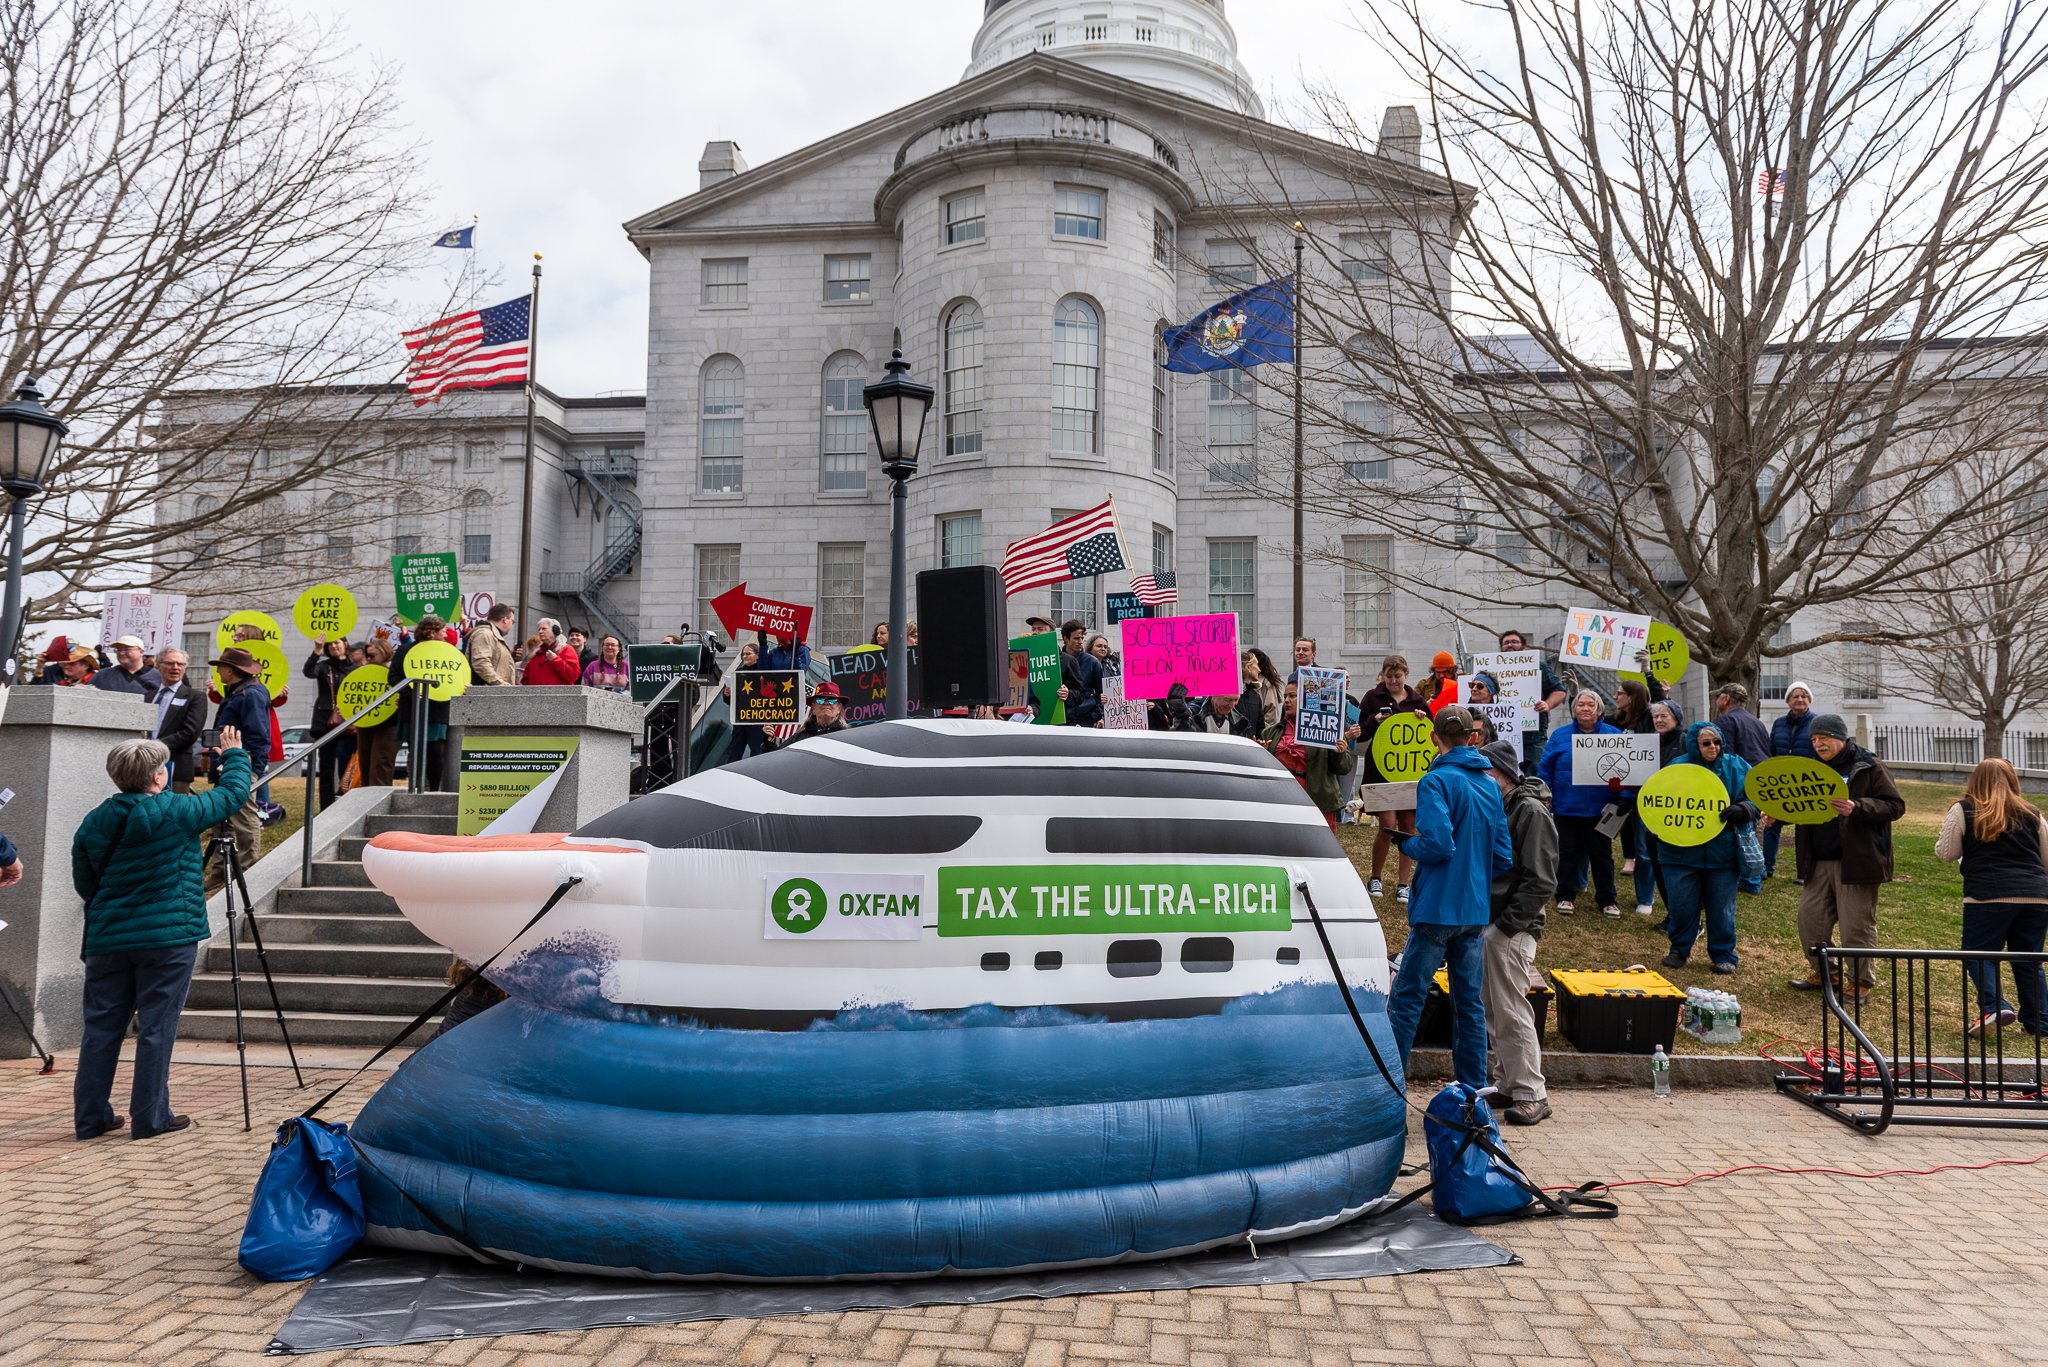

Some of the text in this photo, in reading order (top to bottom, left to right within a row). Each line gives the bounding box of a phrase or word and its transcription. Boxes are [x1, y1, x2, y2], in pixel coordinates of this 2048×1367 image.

[408, 557, 441, 566] PROFITS
[402, 565, 449, 575] DON'T HAVE
[403, 573, 449, 584] TO COME AT
[401, 582, 454, 593] THE EXPENSE
[135, 596, 150, 607] NO
[407, 591, 449, 601] OF PEOPLE
[1108, 597, 1129, 608] TAX
[129, 607, 152, 618] TAX
[311, 609, 339, 619] CARE
[751, 601, 795, 619] CONNECT
[1117, 608, 1144, 619] RICH
[102, 597, 117, 650] IMPEACH
[310, 620, 339, 632] CUTS
[748, 613, 794, 632] THE DOTS
[1573, 612, 1646, 639] TAX THE
[1125, 617, 1236, 647] SOCIAL SECURITY
[1164, 643, 1200, 658] YES!
[1565, 633, 1615, 661] RICH
[411, 659, 462, 671] LIBRARY
[830, 653, 877, 676] LEAD
[1030, 654, 1057, 669] TURE
[1187, 656, 1228, 673] MUSK
[1475, 654, 1535, 666] WE DESERVE
[635, 664, 672, 672] MAINERS
[636, 672, 696, 682] FAIRNESS
[1030, 670, 1051, 683] UAL
[343, 681, 391, 692] FORESTR
[343, 693, 392, 707] SERVIE
[750, 697, 794, 708] DEFEND
[740, 708, 797, 720] DEMOCRACY
[1130, 703, 1146, 714] NOT
[1110, 713, 1143, 727] PAYING
[1300, 711, 1339, 731] FAIR
[1301, 727, 1338, 743] TAXATION
[1390, 723, 1426, 746] CDC
[1576, 737, 1634, 749] NO MORE
[1383, 749, 1432, 773] CUTS
[1628, 750, 1655, 762] CUTS
[1756, 770, 1825, 788] SOCIAL
[1758, 783, 1837, 802] SECURITY
[1643, 795, 1727, 812] MEDICAID
[1782, 799, 1828, 813] CUTS
[1664, 814, 1705, 829] CUTS
[839, 893, 920, 917] OXFAM
[956, 883, 1278, 920] TAX THE ULTRA-RICH
